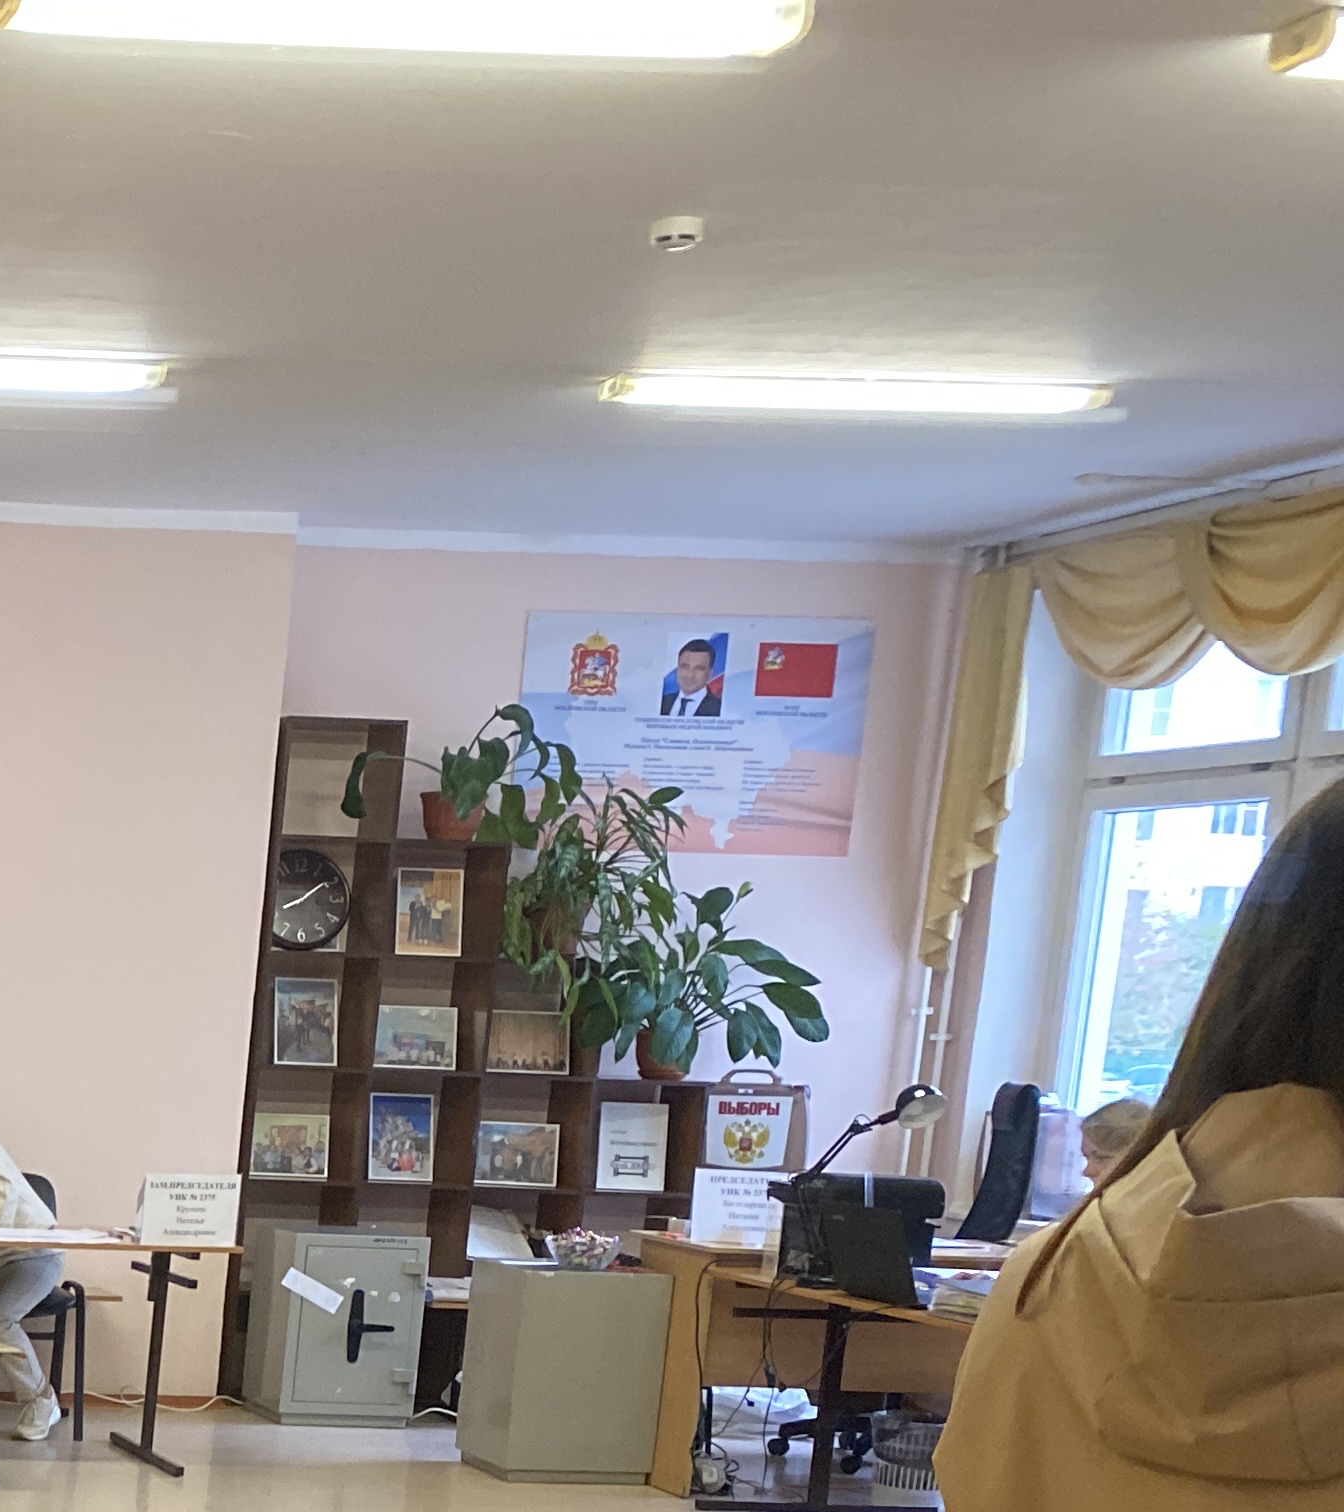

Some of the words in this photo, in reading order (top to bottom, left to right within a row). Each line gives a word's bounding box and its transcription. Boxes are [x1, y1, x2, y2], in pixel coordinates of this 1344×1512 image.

[326, 912, 339, 924] 4
[280, 921, 291, 937] 7
[297, 927, 306, 942] 6
[314, 922, 326, 938] 5
[718, 1101, 781, 1116] ВЫБОРЫ
